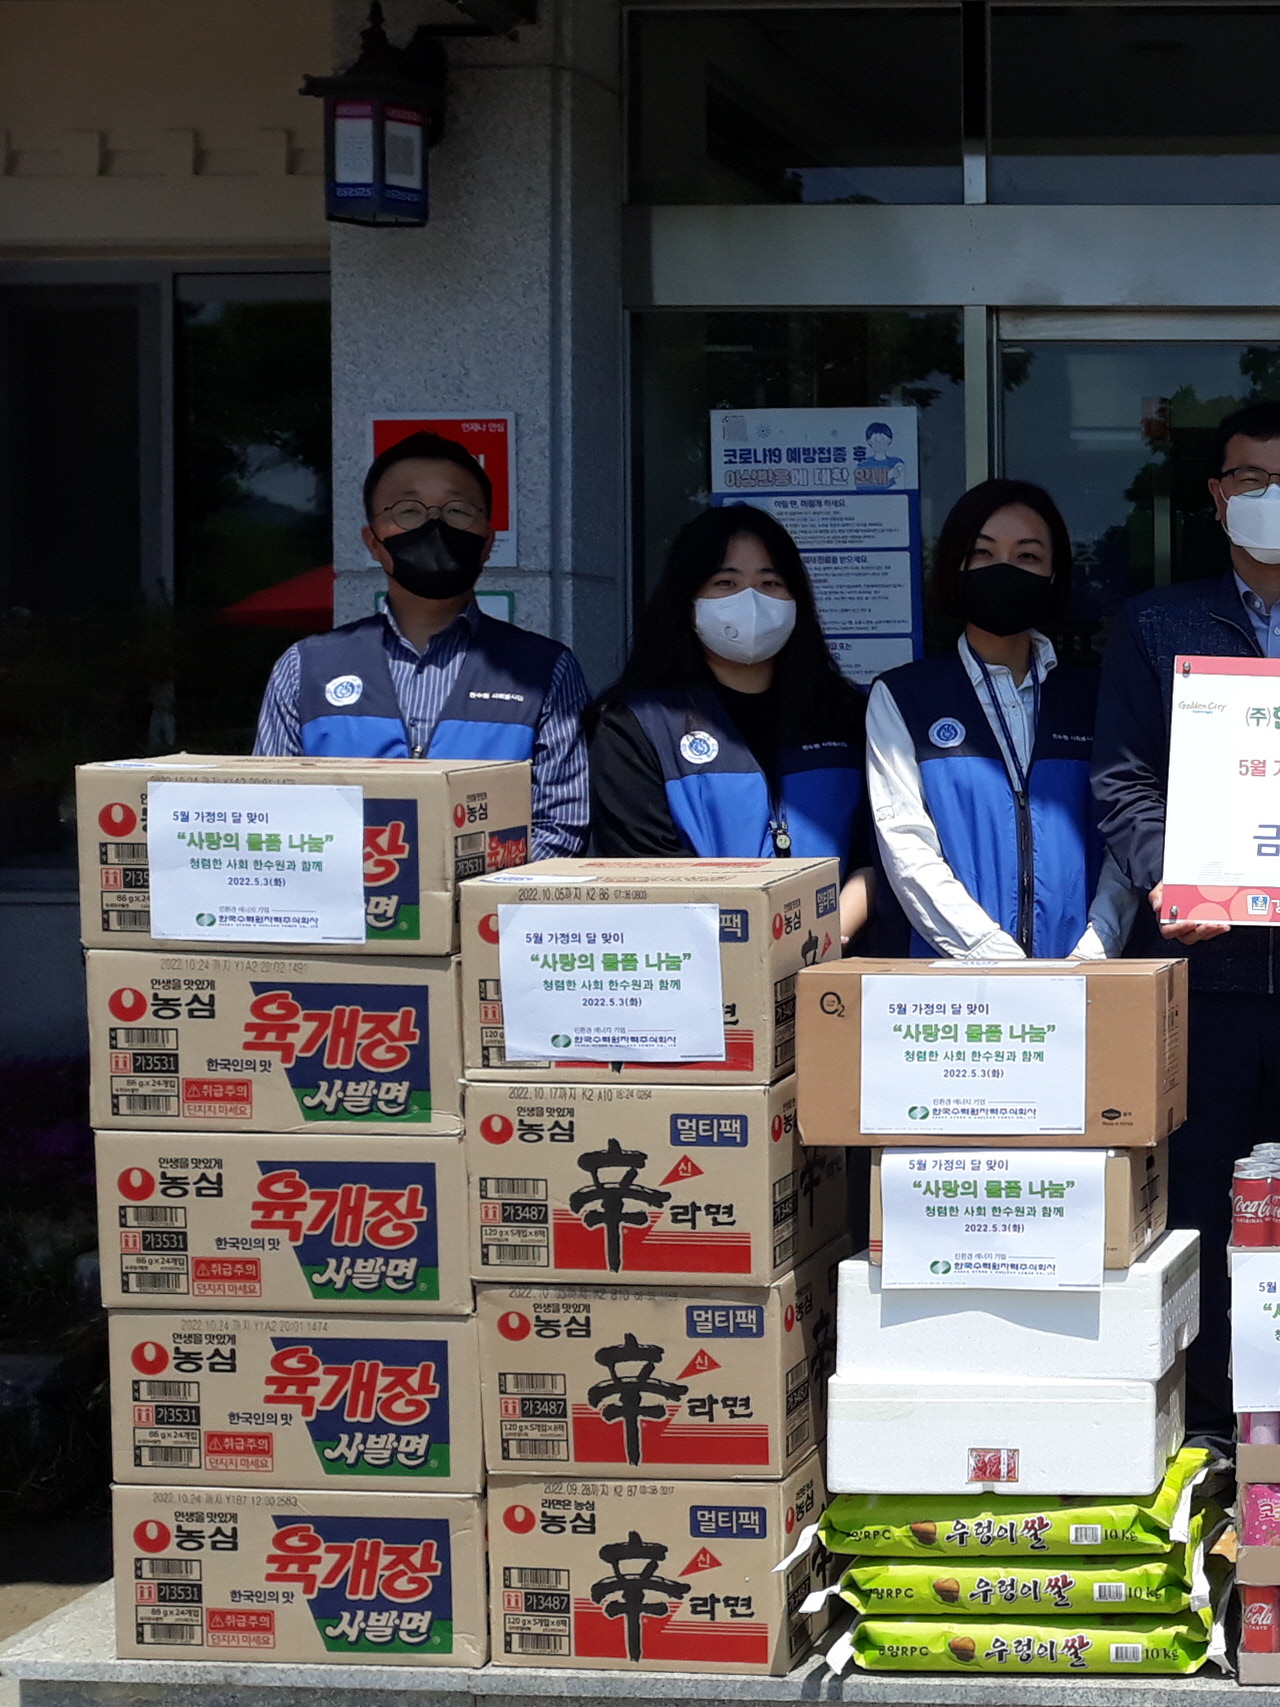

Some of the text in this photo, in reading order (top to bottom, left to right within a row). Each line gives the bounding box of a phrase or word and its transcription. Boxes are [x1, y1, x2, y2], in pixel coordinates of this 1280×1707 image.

[723, 446, 867, 464] 코로나19 예방접종 후
[814, 469, 849, 486] 대한
[1239, 759, 1267, 777] 5월
[177, 832, 333, 854] “사랑의 물품 나눔”
[531, 953, 691, 972] “사랑의 물품 나눔”
[151, 979, 215, 991] 인생을 맛있게
[151, 993, 215, 1019] 농심
[889, 1003, 989, 1015] 5월 가정의 달 맞이
[242, 991, 419, 1071] 육개장
[893, 1024, 1056, 1043] “사랑의 물품 나눔”
[135, 1055, 175, 1070] 가3531
[206, 1058, 272, 1073] 한국인의 맛
[904, 1050, 1044, 1062] 청렴한 사회 한수원과 함께
[943, 1068, 1004, 1079] 2022.5.3(화)
[202, 1084, 247, 1097] 취급주의
[303, 1078, 408, 1114] 사발면
[219, 1105, 247, 1116] 마세요
[517, 1119, 574, 1143] 농심
[677, 1118, 741, 1143] 멀티팩
[679, 1162, 692, 1175] 신
[158, 1170, 223, 1198] 농심
[913, 1179, 1075, 1199] “사랑의 물품 나눔”
[251, 1171, 427, 1249] 육개장
[504, 1206, 546, 1220] 가3487
[570, 1138, 672, 1272] 辛
[670, 1203, 736, 1230] 라면
[313, 1256, 414, 1291] 사발면
[1259, 1282, 1277, 1292] 5월
[533, 1315, 591, 1339] 농심
[693, 1309, 759, 1334] 멀티팩
[172, 1346, 237, 1374] 농심
[263, 1346, 439, 1424] 육개장
[588, 1333, 689, 1466] 辛
[687, 1396, 753, 1422] 라면
[324, 1432, 427, 1467] 사발면
[541, 1499, 595, 1511] 라면은 농심
[540, 1511, 596, 1534] 농심
[697, 1510, 761, 1534] 멀티팩
[174, 1524, 238, 1551] 농심
[264, 1524, 441, 1603] 육개장
[591, 1531, 692, 1662] 辛
[690, 1594, 754, 1621] 라면
[325, 1610, 431, 1645] 사발면
[1145, 1647, 1178, 1661] 10 kg
